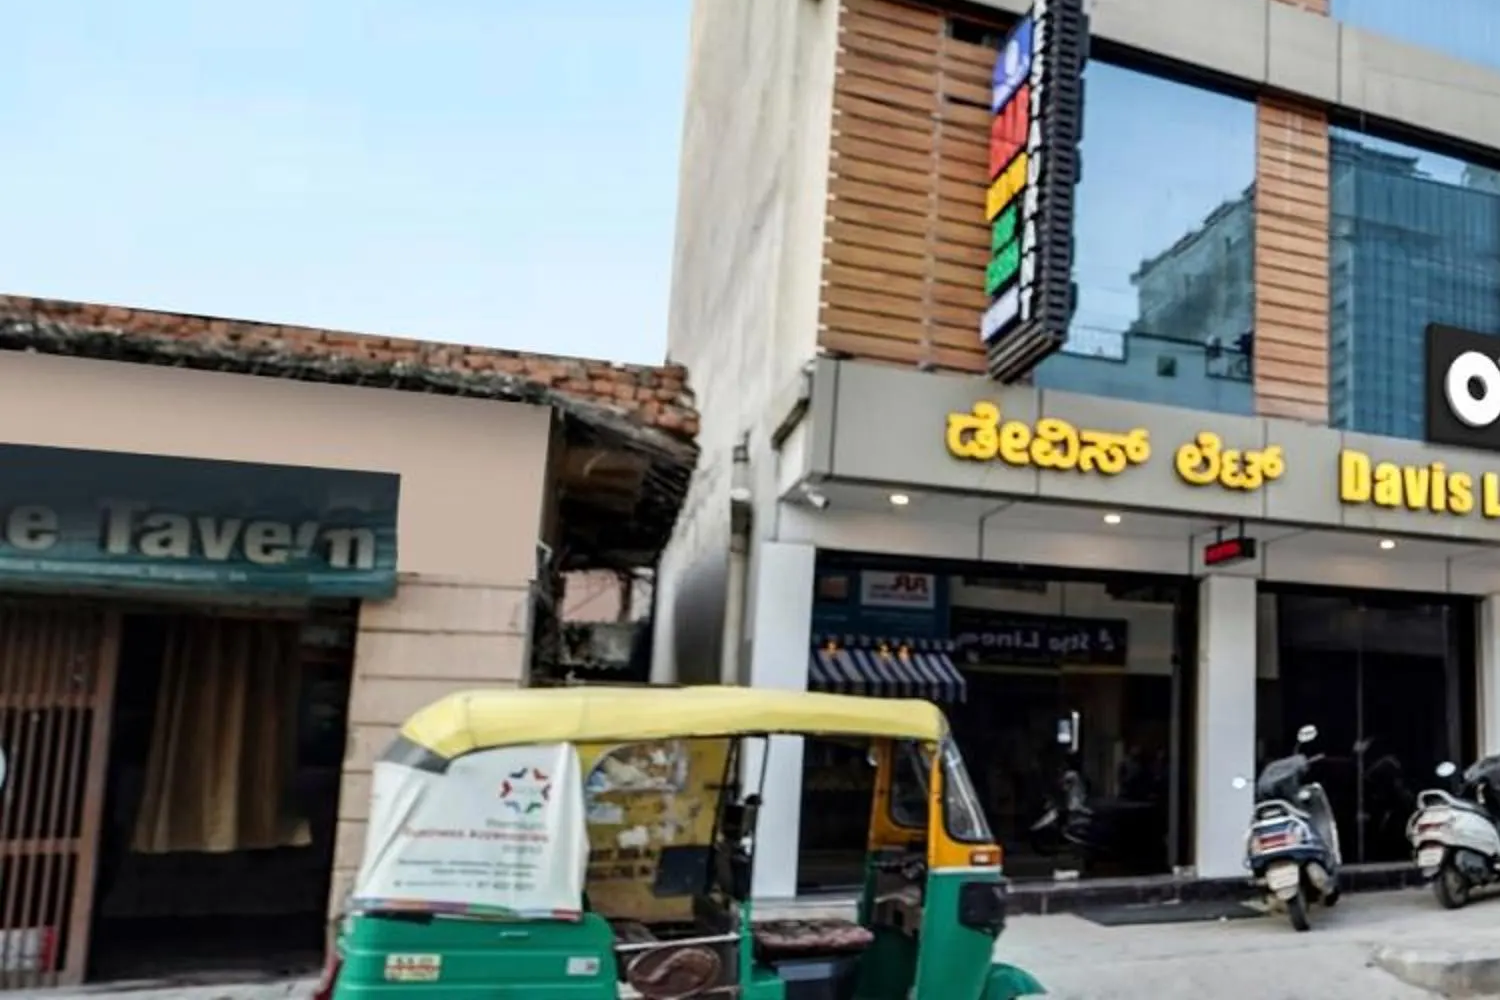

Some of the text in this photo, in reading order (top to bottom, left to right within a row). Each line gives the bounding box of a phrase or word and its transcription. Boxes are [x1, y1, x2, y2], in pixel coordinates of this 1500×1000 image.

[945, 400, 1285, 490] ಡೇವಿಸ್ ಲೆಟ್
[1341, 452, 1473, 514] Davis
